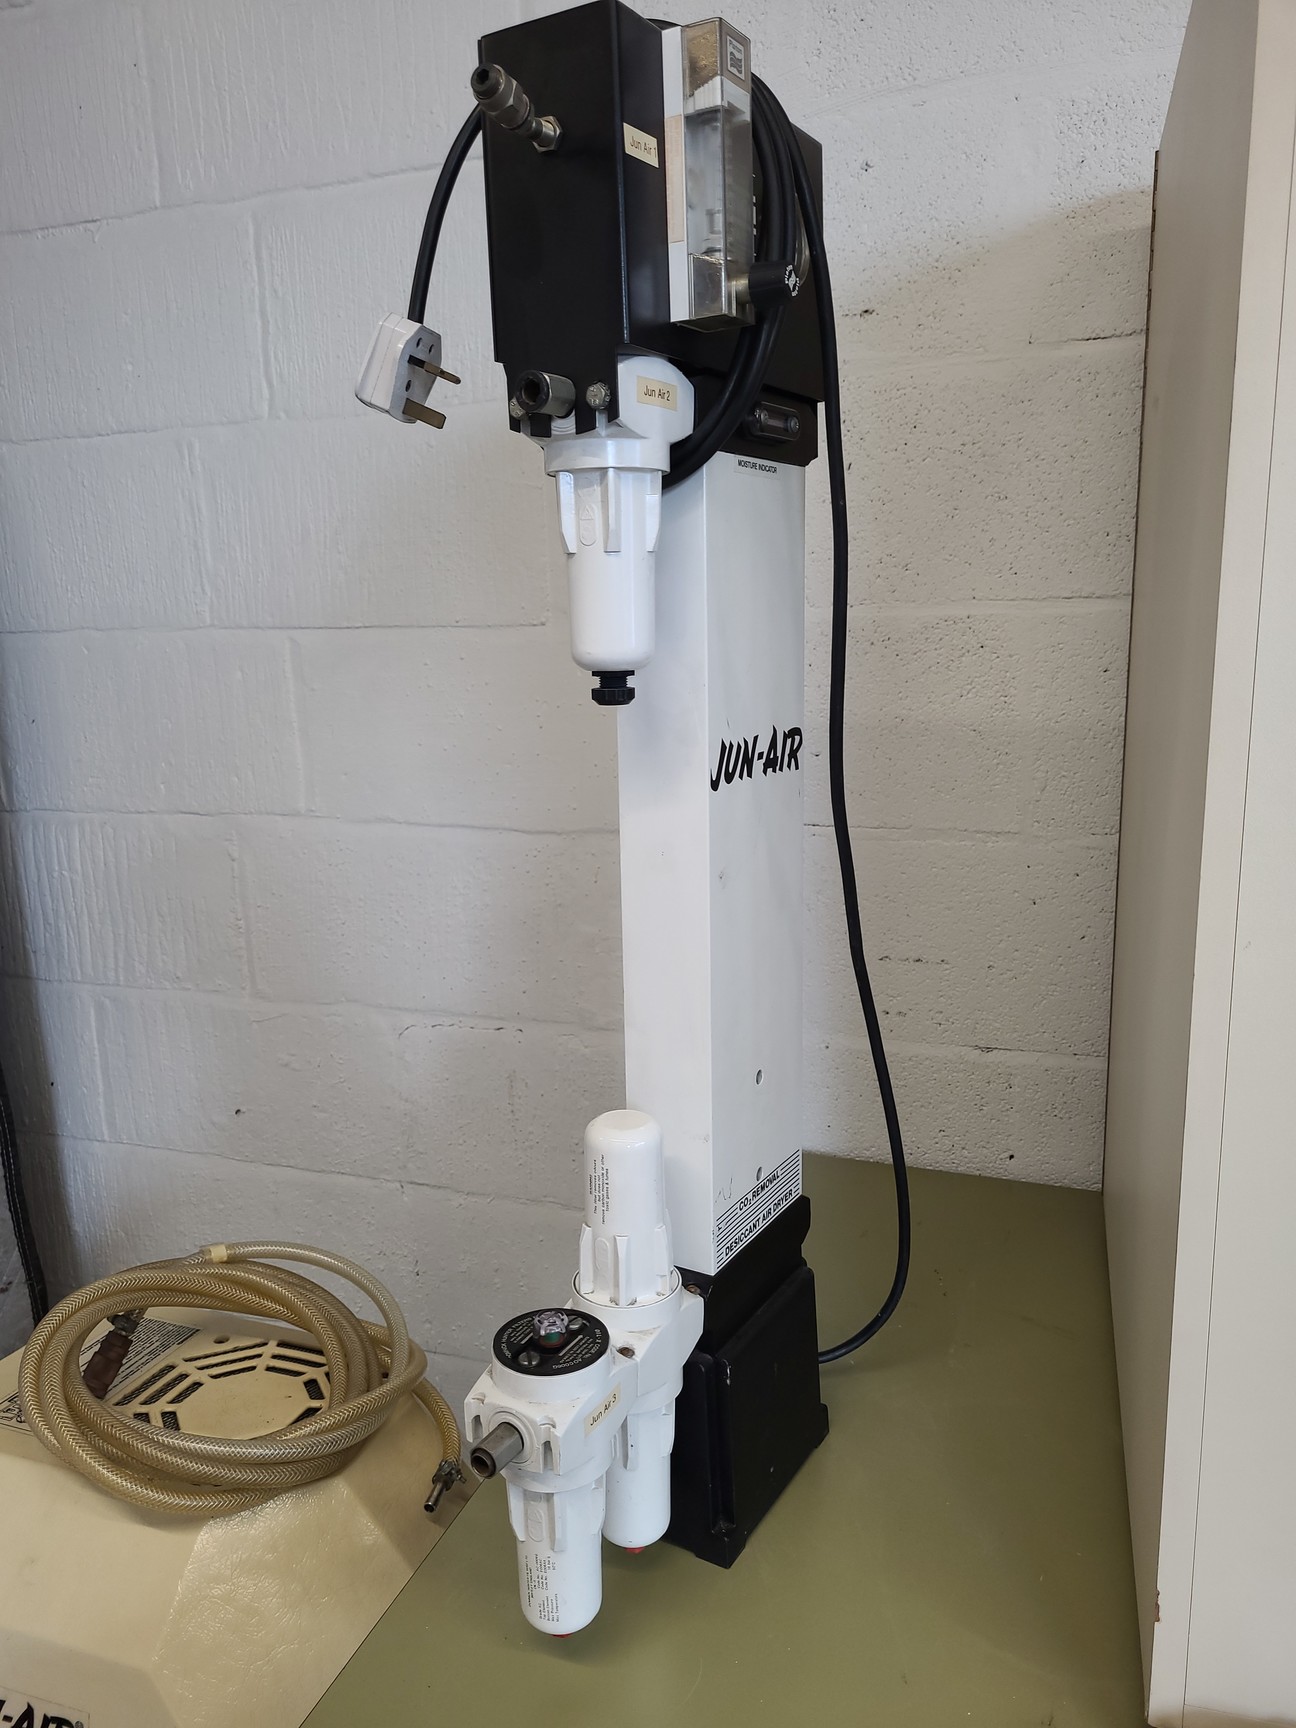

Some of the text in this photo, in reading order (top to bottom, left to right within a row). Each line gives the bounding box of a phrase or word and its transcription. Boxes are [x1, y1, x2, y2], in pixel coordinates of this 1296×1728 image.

[630, 136, 642, 151] Jun
[644, 142, 652, 156] Air
[644, 385, 656, 398] Jun
[658, 388, 666, 400] Air
[737, 459, 778, 475] MOISTURE INDICATOR
[710, 724, 803, 792] JUN-AIR
[752, 1170, 780, 1200] REMOVAL
[725, 1188, 794, 1257] DESICCANT AIR DRYER
[590, 1411, 602, 1426] Jun
